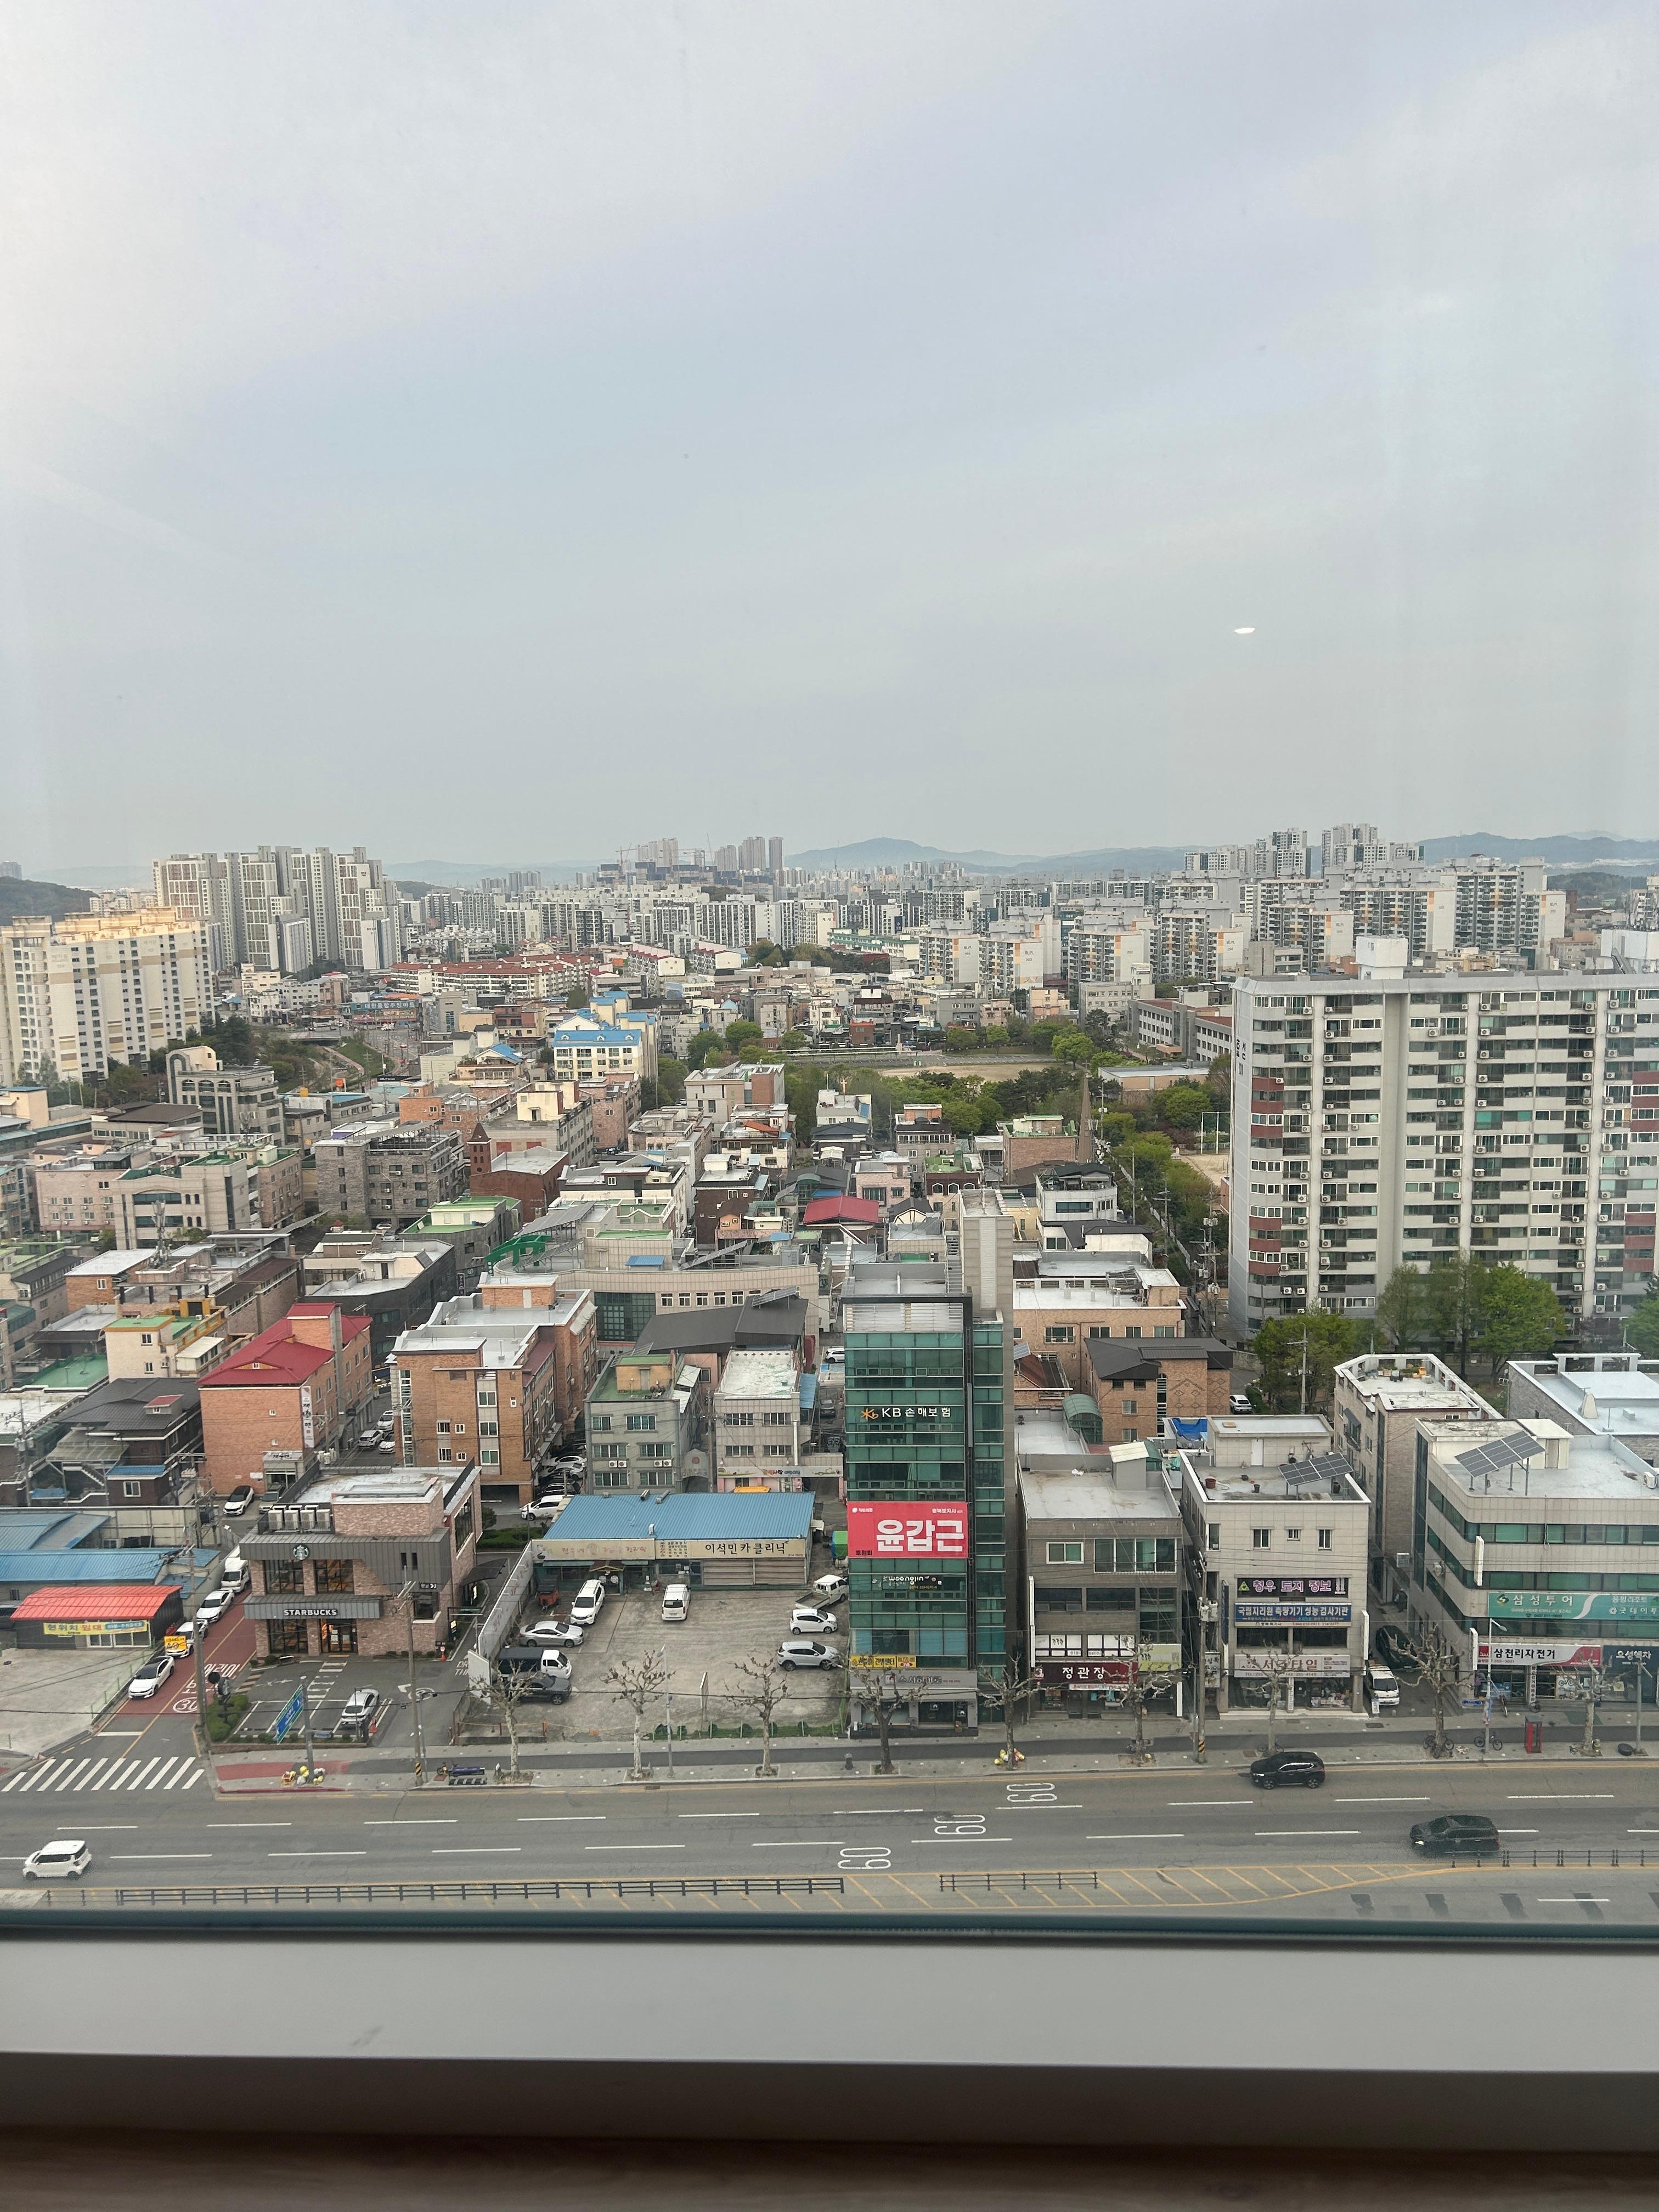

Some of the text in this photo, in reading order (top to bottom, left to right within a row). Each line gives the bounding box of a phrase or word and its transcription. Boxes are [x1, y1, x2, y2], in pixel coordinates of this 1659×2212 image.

[882, 1407, 950, 1418] KB 손해보험
[876, 1519, 964, 1552] 윤갑근
[705, 1543, 785, 1555] 이석민카클리닉
[888, 1576, 924, 1585] woongjin
[1253, 1579, 1276, 1593] 청우
[1280, 1580, 1304, 1592] 토지
[1308, 1580, 1331, 1593] 정보
[1513, 1594, 1573, 1606] 삼성투어
[1238, 1606, 1348, 1616] 국립지리원 측량기기 성능 검사기관
[81, 1623, 102, 1632] 임대
[1494, 1648, 1555, 1660] 삼천리자전거
[1062, 1667, 1105, 1679] 정관장
[1006, 1782, 1058, 1802] 60
[934, 1814, 987, 1835] 60
[837, 1847, 891, 1870] 60
